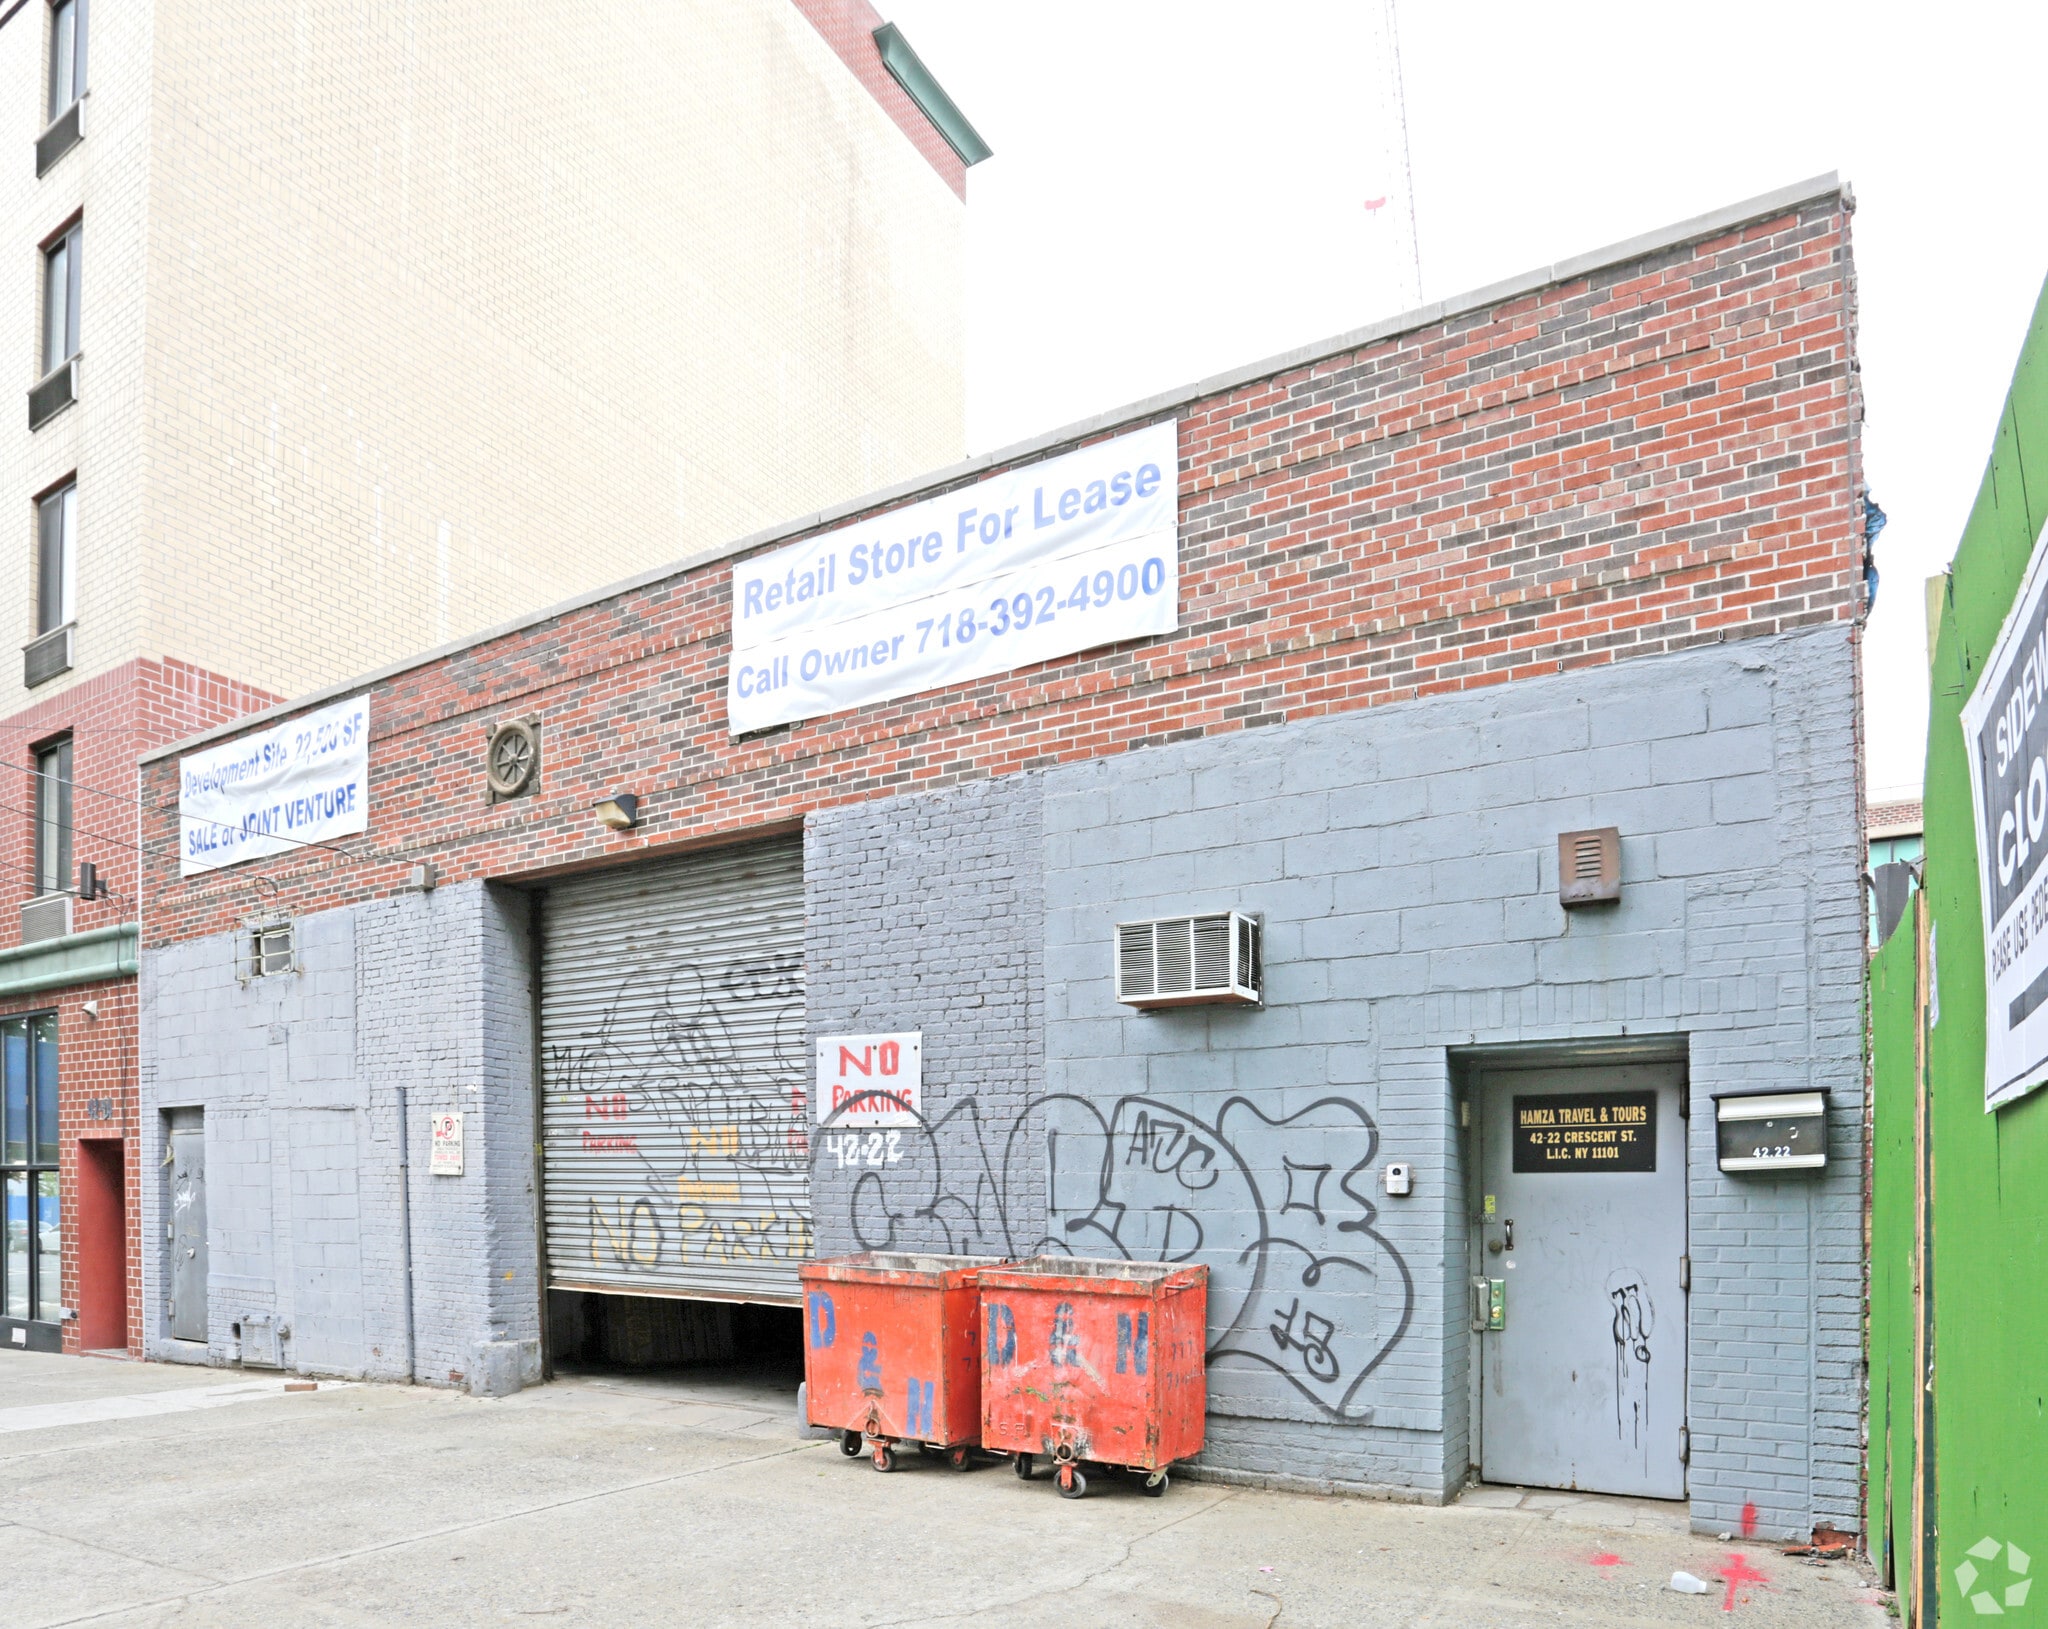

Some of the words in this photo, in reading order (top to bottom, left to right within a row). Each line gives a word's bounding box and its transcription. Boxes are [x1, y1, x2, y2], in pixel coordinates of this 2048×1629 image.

[743, 553, 836, 619] Retail
[848, 530, 943, 586] Store
[957, 504, 1020, 553] For
[1033, 462, 1162, 529] Lease
[736, 655, 789, 699] Call
[800, 633, 905, 682] Owner
[915, 556, 1166, 653] 718-392-4900
[184, 749, 260, 798] Development
[263, 741, 288, 772] Site
[343, 712, 363, 746] SF
[188, 822, 218, 856] SALE
[221, 826, 236, 847] or
[239, 805, 281, 842] JOINT
[285, 783, 357, 830] VENTURE
[1998, 755, 2048, 887] CLO
[1991, 924, 2011, 987] PLEASE
[2013, 904, 2028, 959] USE
[838, 1040, 900, 1077] NO
[583, 1092, 628, 1121] NO
[832, 1084, 913, 1114] PARKING
[1520, 1109, 1556, 1125] HAMZA
[1558, 1107, 1597, 1124] TRAVEL
[1600, 1107, 1608, 1123] &
[1612, 1105, 1647, 1122] TOURS
[582, 1130, 638, 1154] PARKING
[690, 1125, 739, 1156] NO
[1529, 1131, 1561, 1144] 42-22
[1564, 1130, 1617, 1143] CRESCENT
[1620, 1130, 1637, 1142] ST.
[1546, 1148, 1571, 1160] L.I.C.
[1575, 1147, 1589, 1159] NY
[1592, 1146, 1619, 1159] 11101
[588, 1196, 665, 1271] NO
[808, 1290, 836, 1350] D
[988, 1303, 1016, 1366] D
